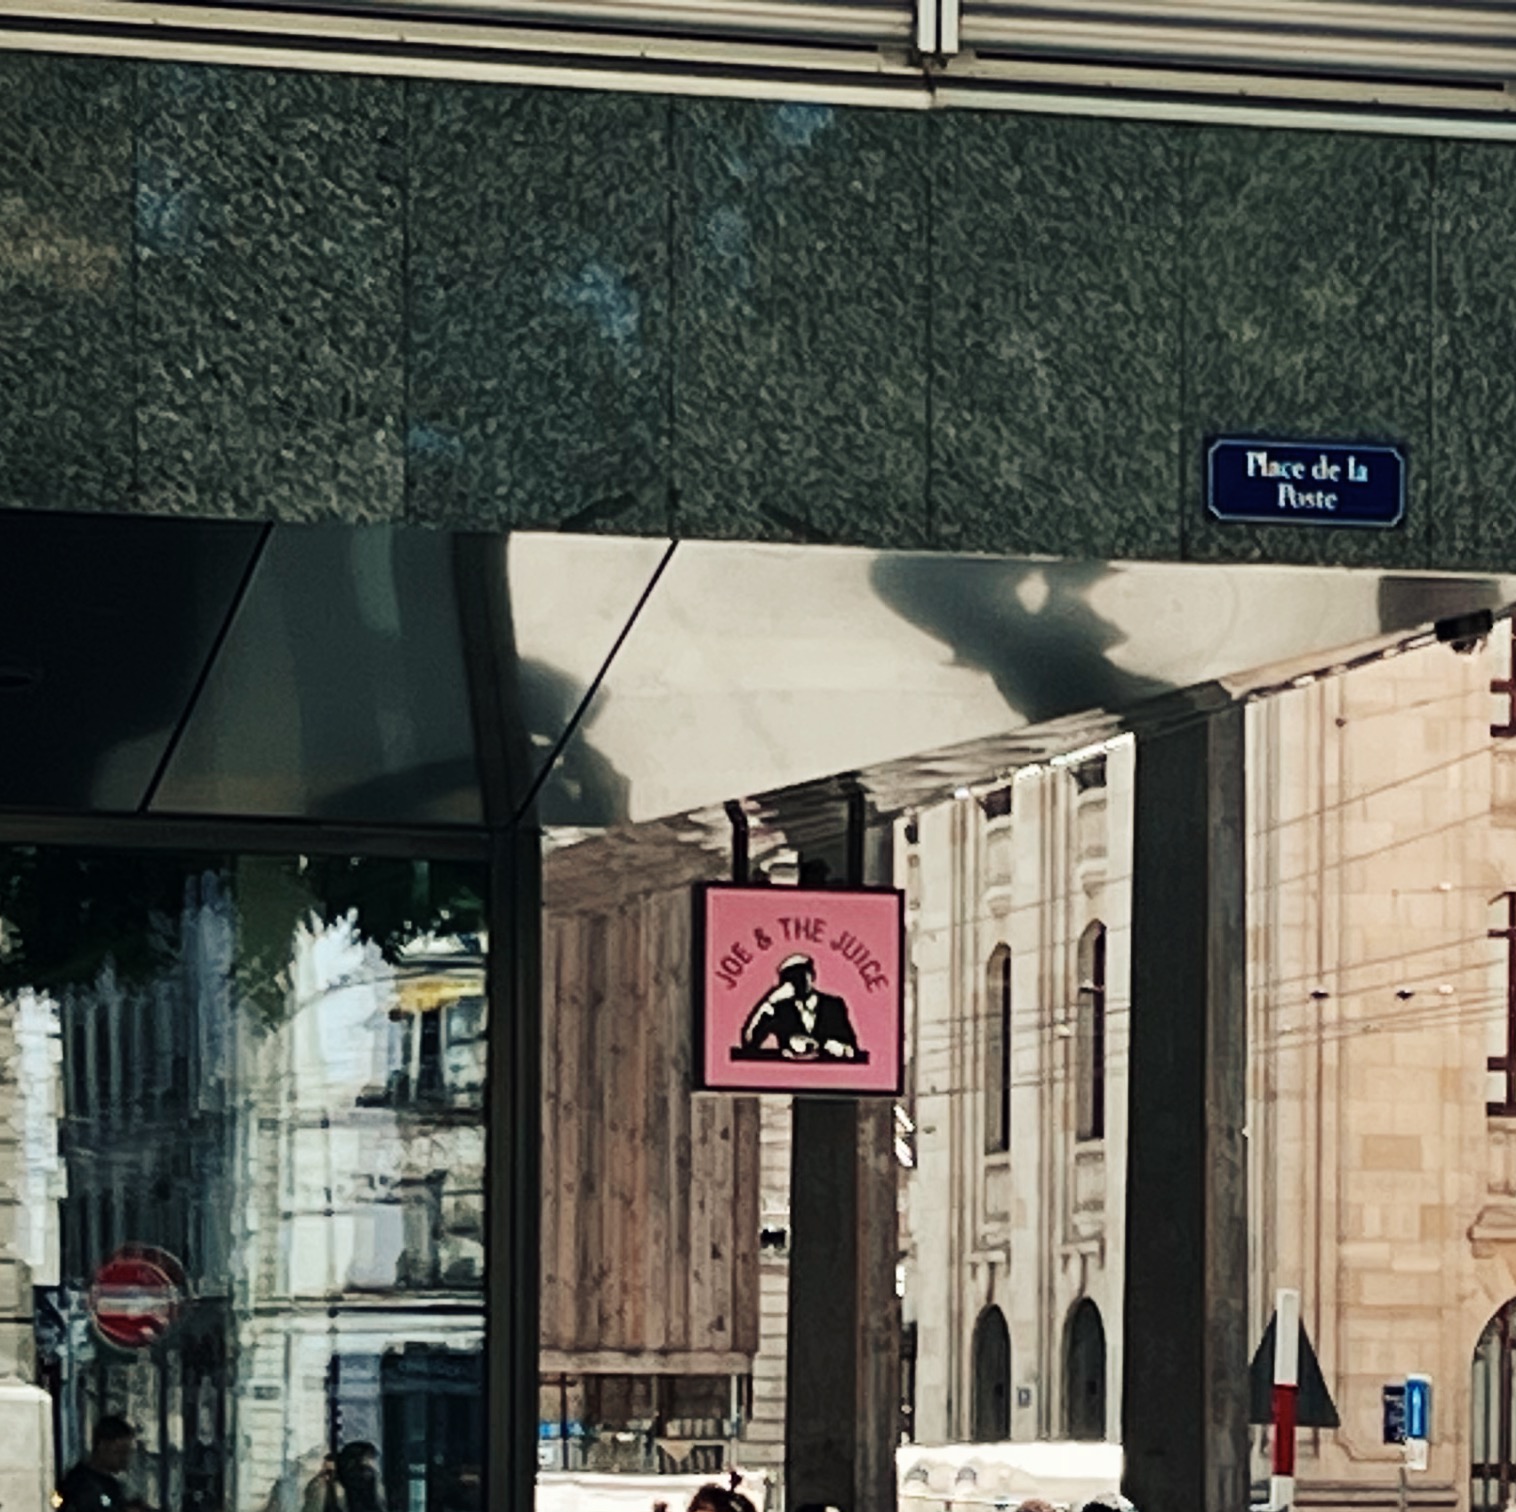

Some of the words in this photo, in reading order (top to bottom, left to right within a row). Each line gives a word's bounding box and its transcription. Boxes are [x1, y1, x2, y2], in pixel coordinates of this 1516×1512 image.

[1245, 451, 1305, 480] Place
[1311, 454, 1341, 482] de
[1348, 455, 1369, 483] la
[1277, 482, 1338, 511] Poste
[715, 941, 753, 990] JOE
[753, 928, 773, 950] &
[777, 917, 827, 943] THE
[830, 931, 889, 994] JUICE
